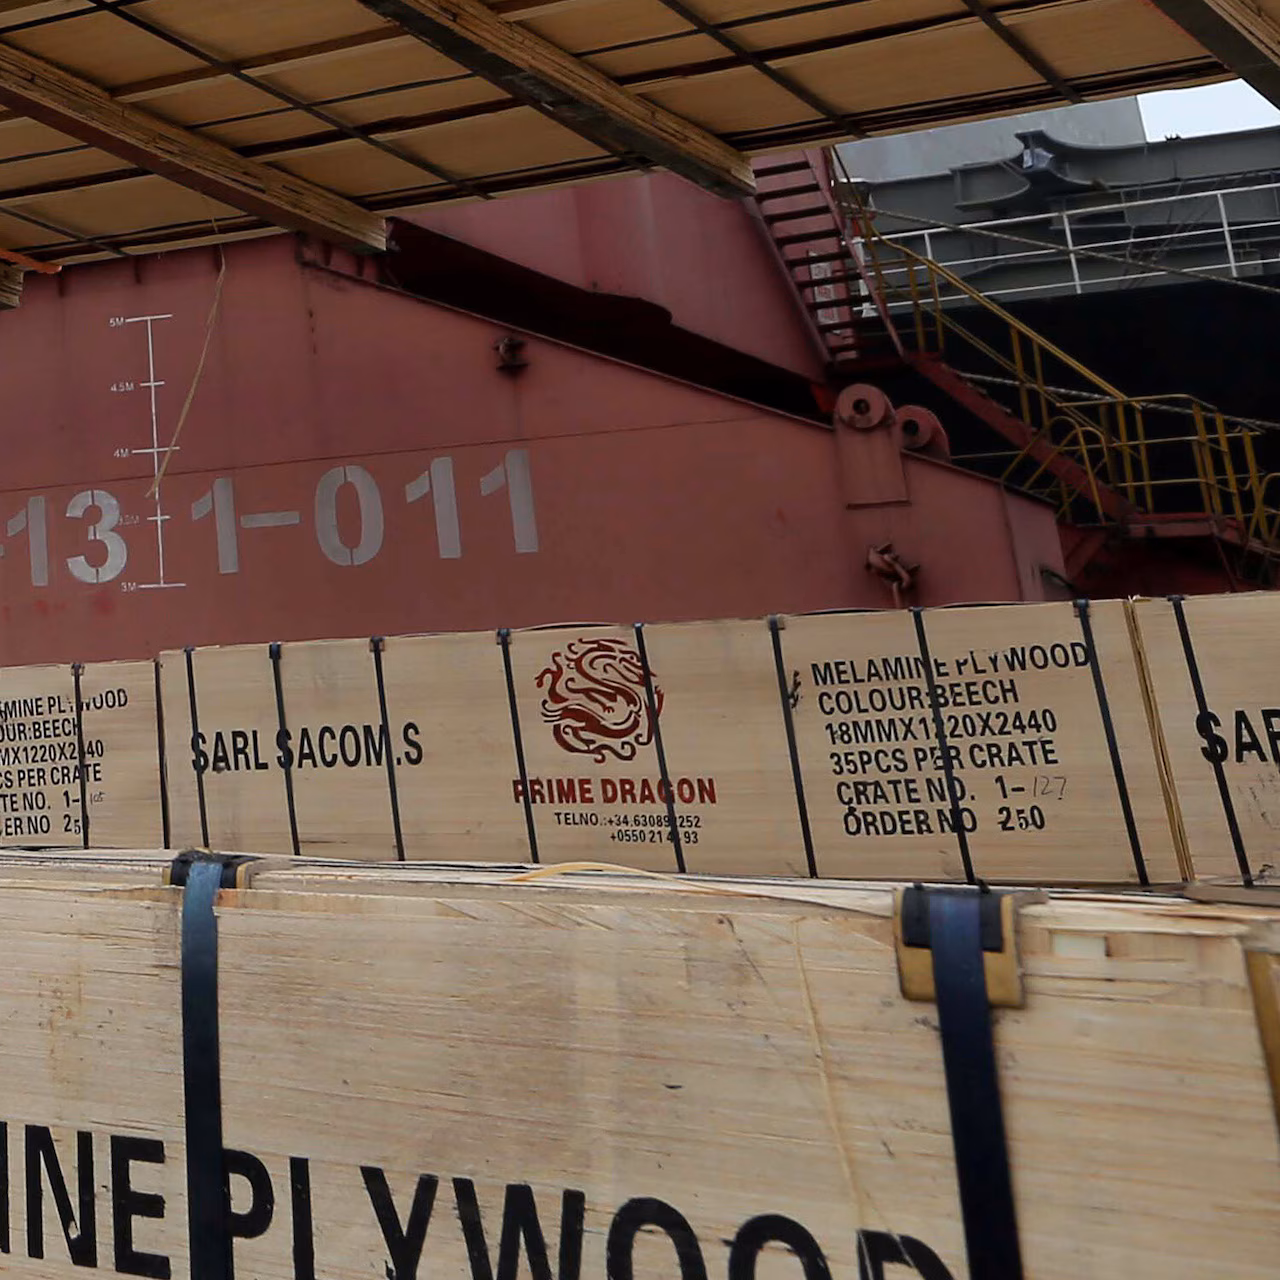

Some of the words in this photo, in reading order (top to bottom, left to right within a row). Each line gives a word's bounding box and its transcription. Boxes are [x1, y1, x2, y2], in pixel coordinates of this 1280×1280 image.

[48, 688, 128, 715] PLOOD
[825, 708, 1057, 746] 18MMX120X2440
[191, 729, 269, 774] SARL
[276, 722, 423, 770] SACOM.S
[830, 747, 908, 776] 35PCS
[969, 739, 1059, 769] CRATE
[17, 768, 46, 789] PER
[51, 763, 102, 786] CRATE
[23, 791, 51, 812] NO.
[512, 777, 594, 804] PRIME
[601, 777, 717, 805] DRAGON
[836, 777, 925, 807] CRATE
[927, 775, 976, 803] NO.
[28, 815, 51, 835] NO
[843, 806, 934, 836] ORDER
[997, 805, 1045, 832] 250
[649, 830, 663, 844] 21
[684, 831, 699, 844] 93
